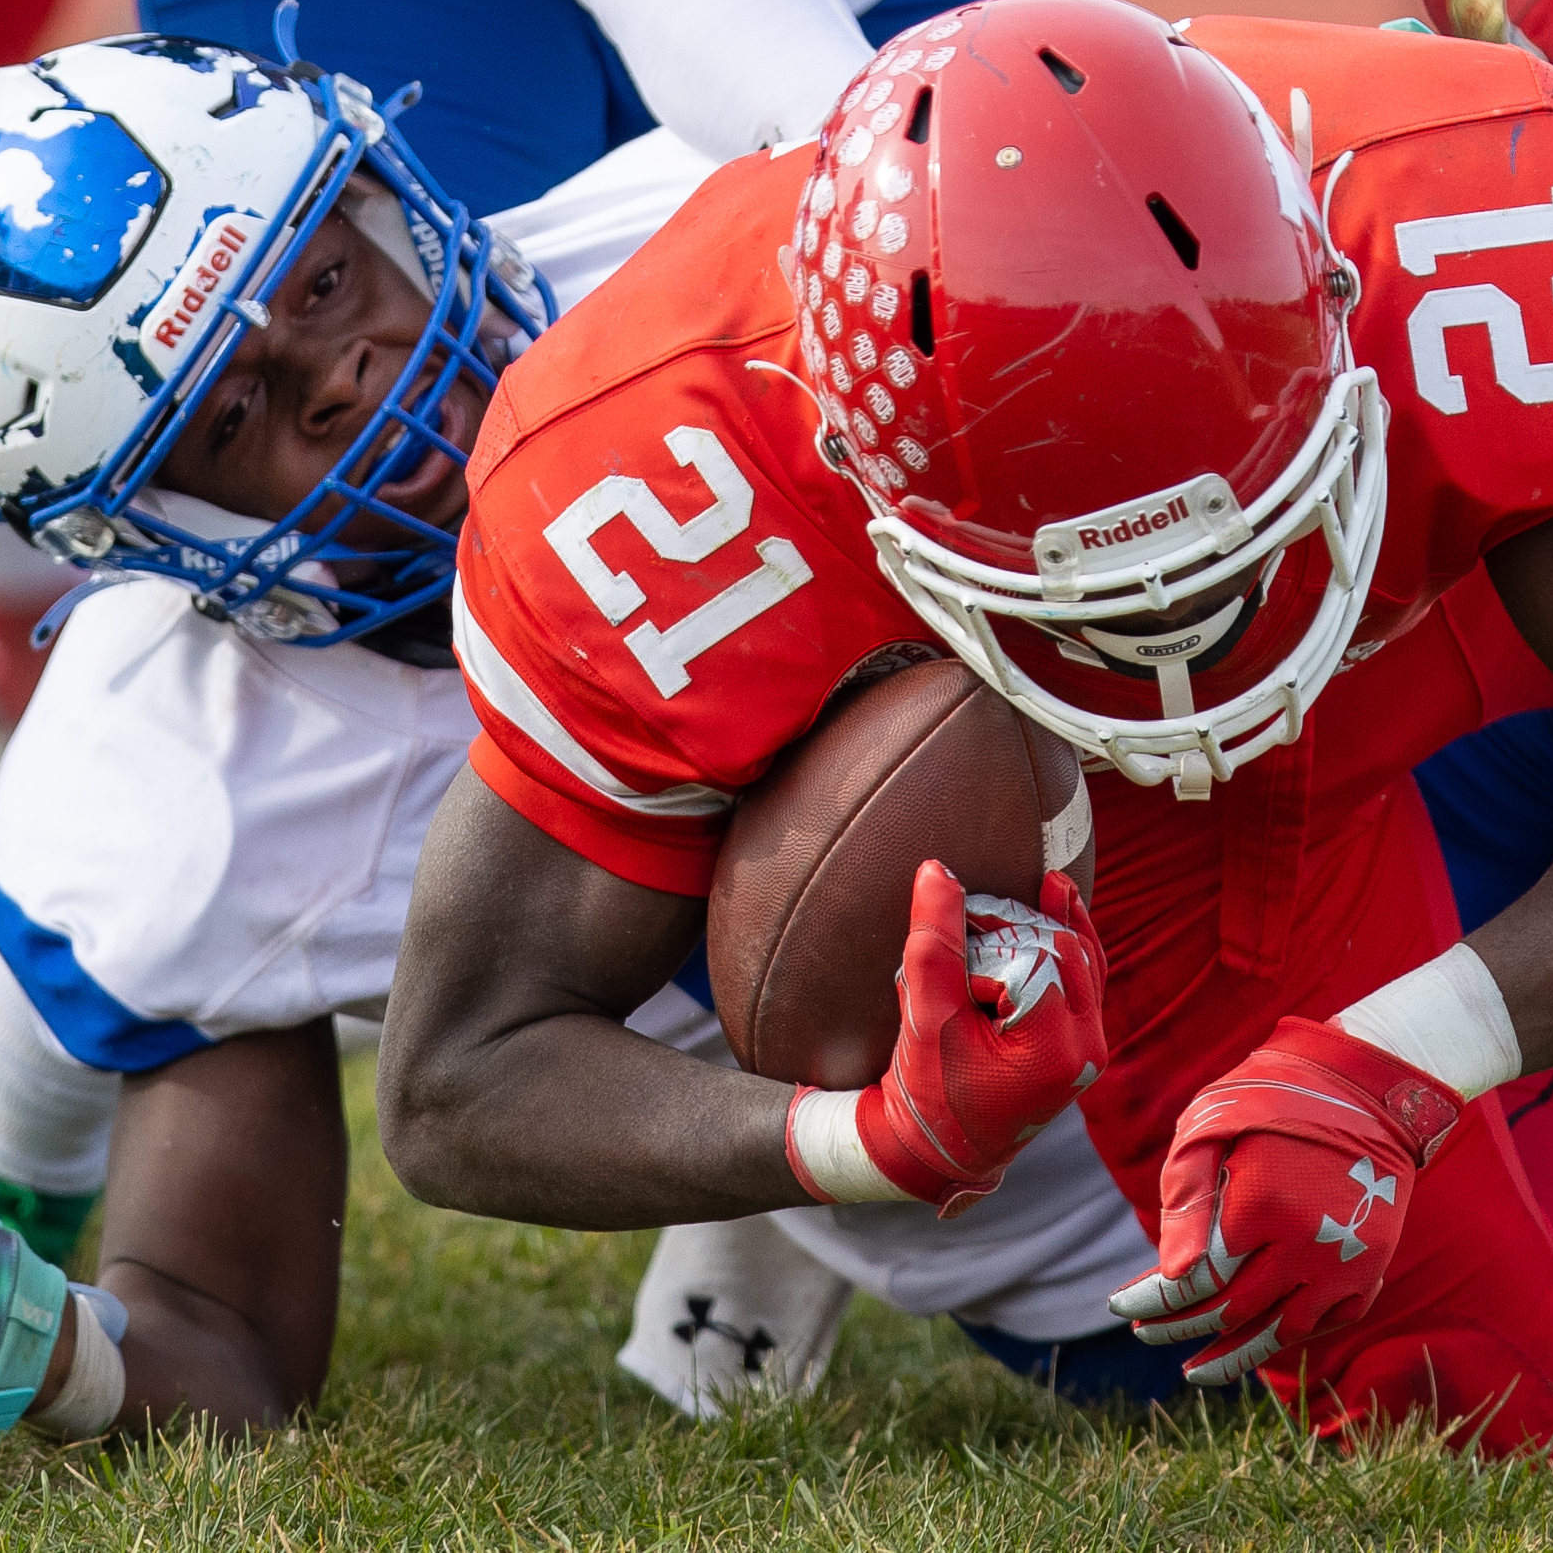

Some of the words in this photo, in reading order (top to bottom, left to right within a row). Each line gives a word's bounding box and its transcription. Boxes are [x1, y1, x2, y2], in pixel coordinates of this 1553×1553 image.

[155, 225, 248, 348] Riddell
[846, 266, 867, 304] PRIDE
[872, 284, 899, 321] PRIDE
[823, 302, 842, 340] PRIDE
[853, 333, 877, 370] PRIDE
[886, 350, 917, 388] PRIDE
[830, 357, 852, 392] PRIDE
[867, 383, 895, 421] PRIDE
[896, 439, 929, 471] PRIDE
[1076, 494, 1190, 550] Riddell
[543, 425, 815, 699] 21
[1144, 636, 1196, 656] BATTLE
